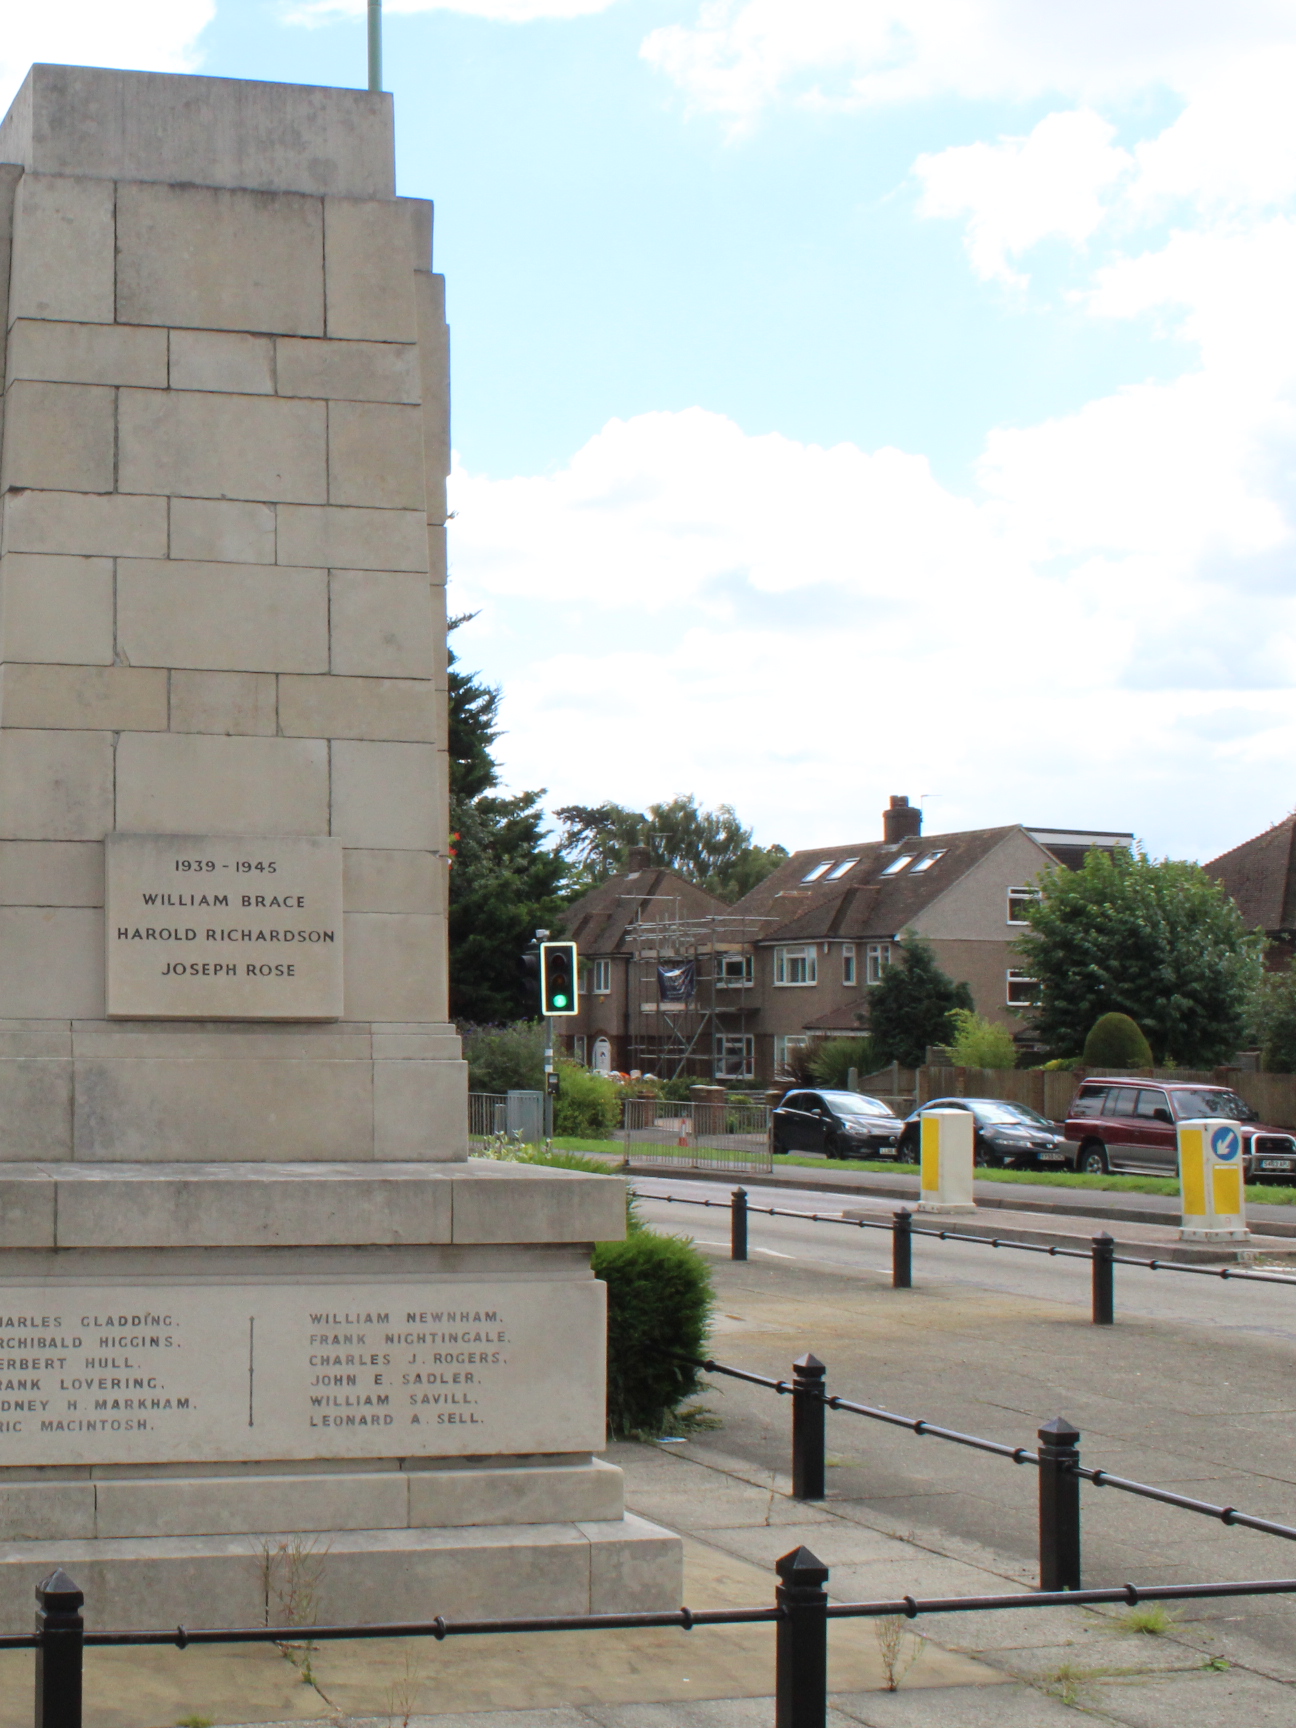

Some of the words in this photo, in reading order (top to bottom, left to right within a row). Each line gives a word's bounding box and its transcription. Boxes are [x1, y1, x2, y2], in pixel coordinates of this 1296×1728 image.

[174, 860, 216, 873] 1939
[235, 861, 277, 874] 1945
[142, 893, 229, 907] WILLIAM
[241, 895, 305, 908] BRACE
[117, 927, 197, 941] HAROLD
[206, 929, 335, 943] RICHARDSON
[161, 962, 237, 976] JOSEPH
[246, 964, 296, 977] ROSE
[81, 1315, 181, 1327] GLADDING.
[309, 1313, 390, 1325] WILLIAM
[406, 1311, 503, 1323] NEWNHAM.
[99, 1336, 182, 1348] HIGGINS.
[310, 1334, 367, 1345] FRANK
[385, 1331, 511, 1344] NIGHTINGALE.
[86, 1357, 141, 1369] HULL.
[309, 1354, 391, 1366] CHARLES
[60, 1378, 165, 1390] LOVERING.
[311, 1374, 357, 1386] JOHN
[402, 1372, 482, 1385] SADLER.
[94, 1398, 197, 1410] MARKHAM.
[310, 1395, 390, 1407] WILLIAM
[410, 1393, 479, 1405] SAVILL.
[41, 1419, 155, 1432] MACINTOSH.
[309, 1415, 394, 1427] LEONARD
[437, 1413, 485, 1424] SELL.
